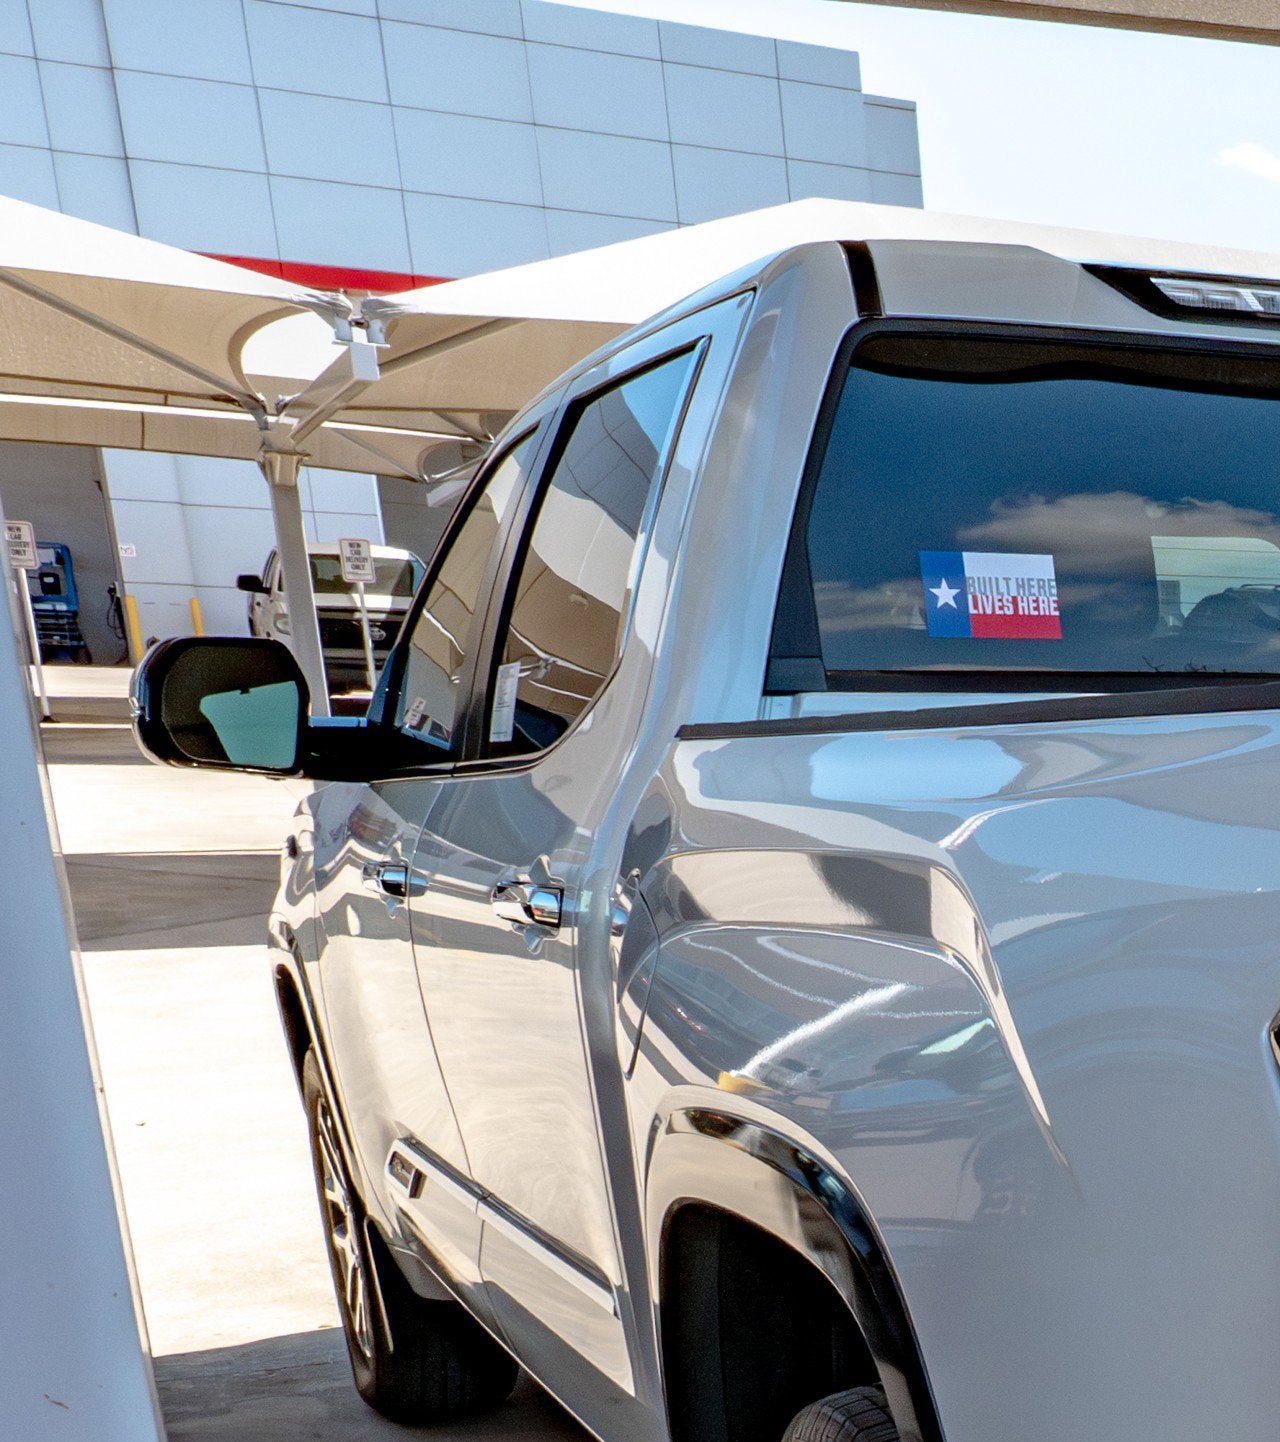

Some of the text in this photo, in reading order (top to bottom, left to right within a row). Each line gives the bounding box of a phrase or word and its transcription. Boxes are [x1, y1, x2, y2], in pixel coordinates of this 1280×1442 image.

[966, 576, 1057, 597] BUILT HERE
[967, 595, 1060, 616] LIVES HERE
